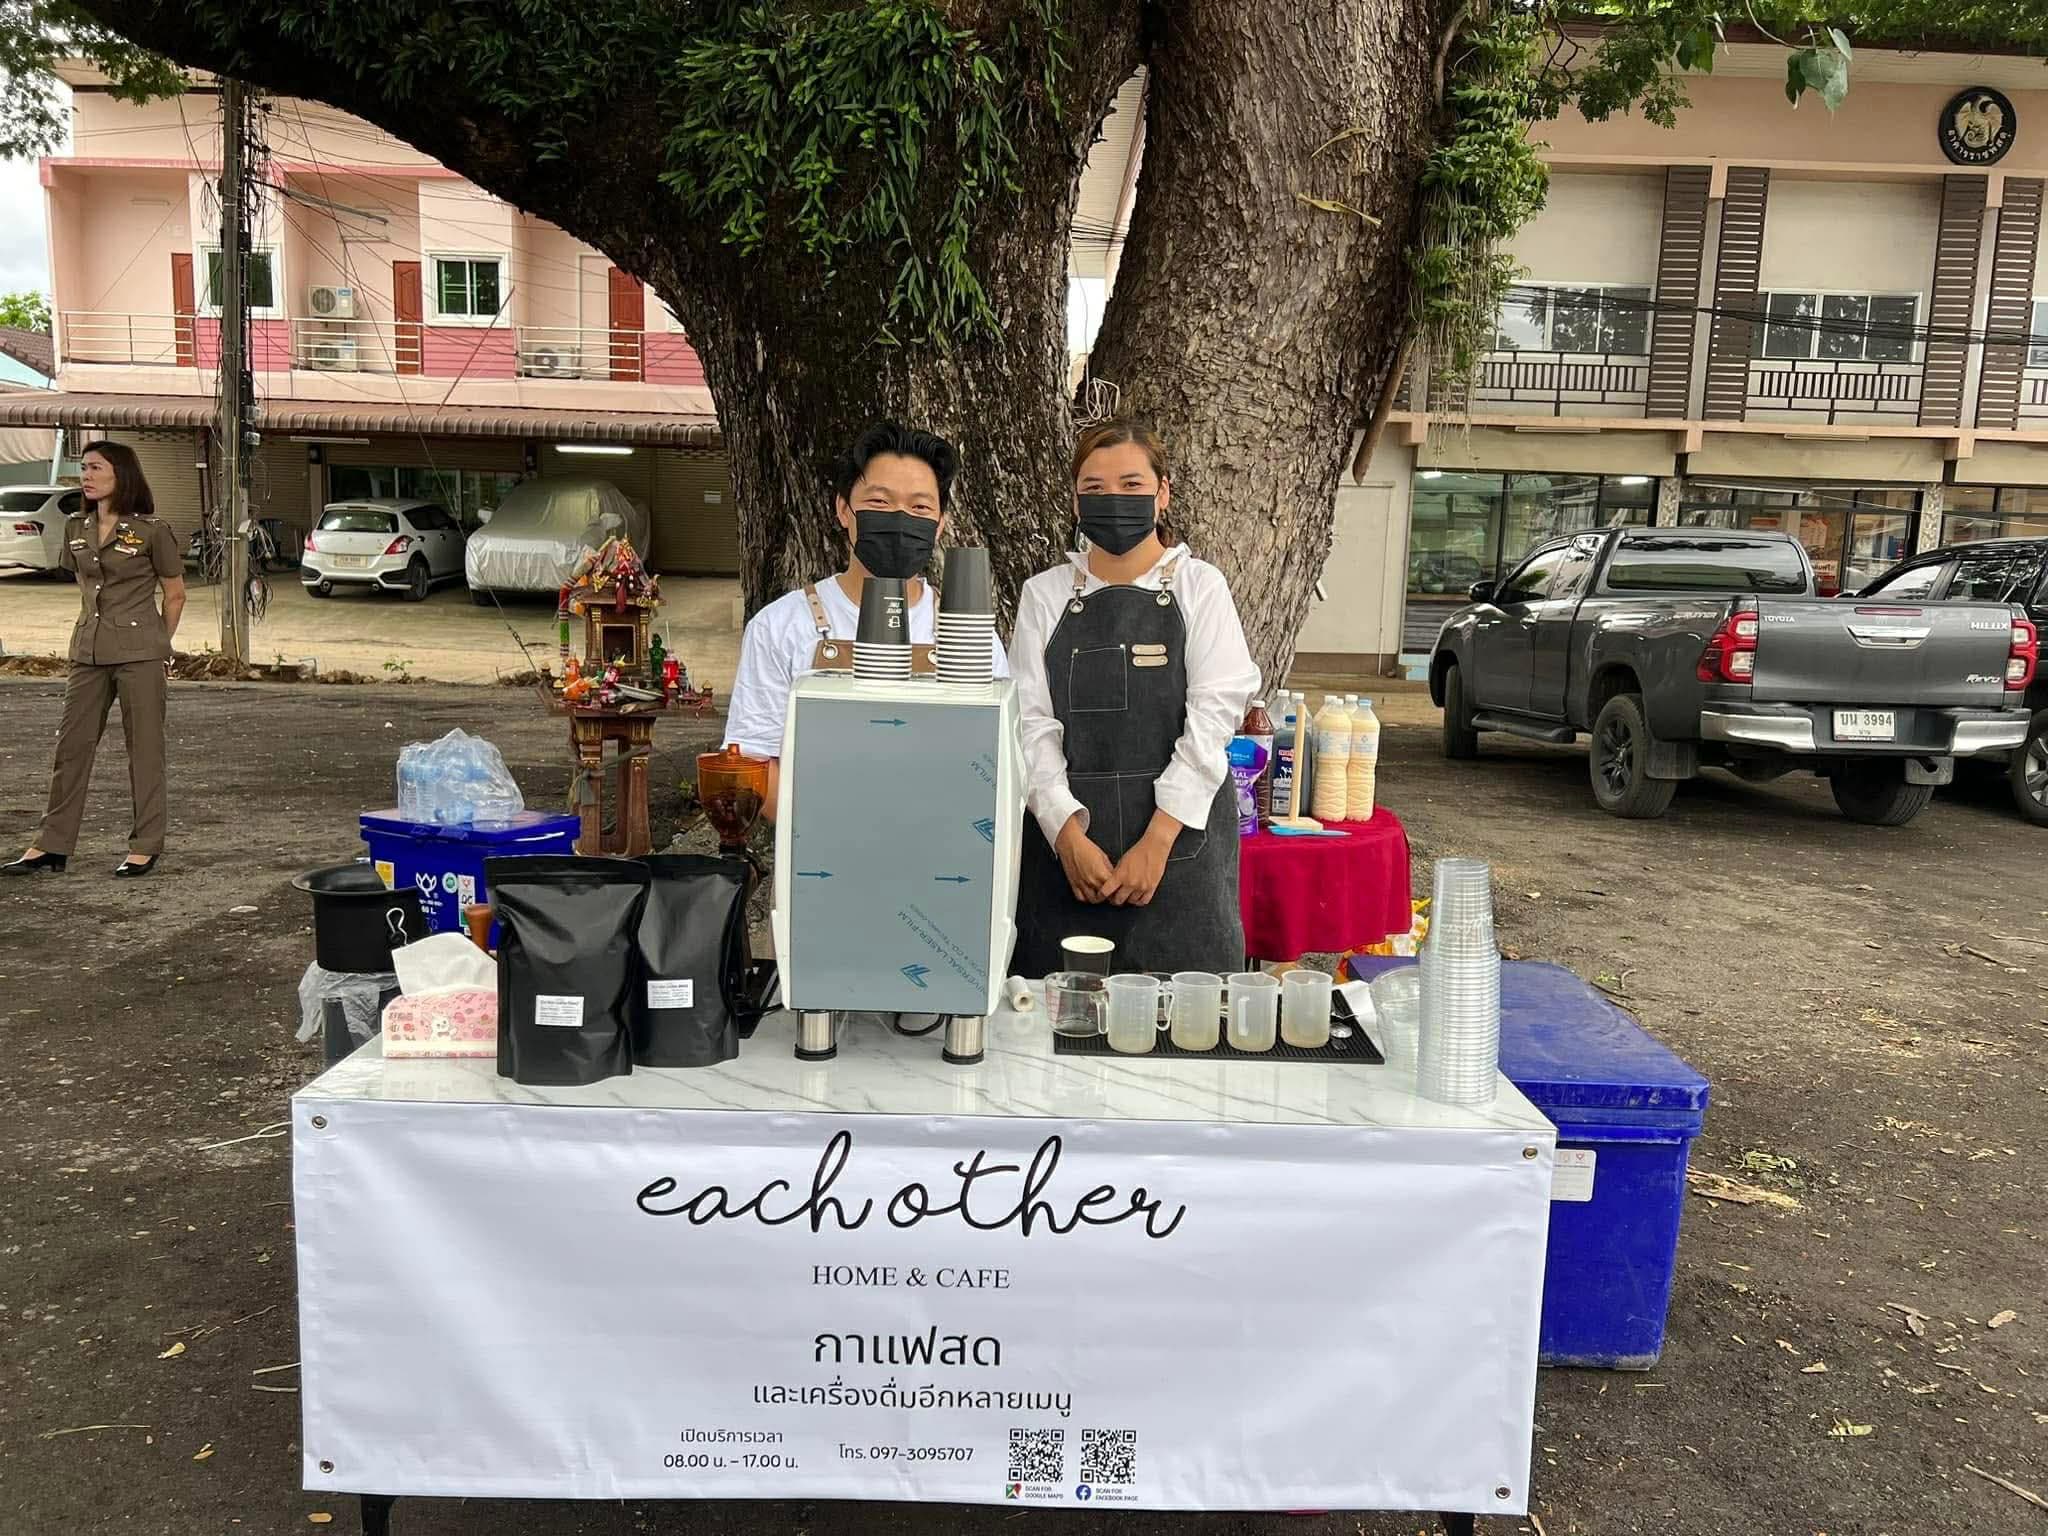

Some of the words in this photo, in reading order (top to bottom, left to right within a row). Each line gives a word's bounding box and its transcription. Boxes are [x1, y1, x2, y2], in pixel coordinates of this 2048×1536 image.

[1970, 621, 2008, 630] HILUX
[1863, 713, 1892, 727] 3994
[636, 1130, 873, 1233] each
[886, 1135, 1187, 1239] other
[811, 1265, 898, 1287] HOME
[906, 1266, 928, 1287] &
[936, 1267, 1011, 1289] CAFE
[814, 1325, 1002, 1366] กาแฟสด
[753, 1375, 1072, 1418] และเครื่องดื่มอีกหลายเมนู
[680, 1427, 783, 1444] เปิดบริการเวลา
[663, 1453, 709, 1468] 08.00
[713, 1455, 727, 1469] น.
[744, 1454, 781, 1469] 17.00
[785, 1456, 799, 1470] น.
[839, 1442, 866, 1460] โทร.
[870, 1446, 975, 1462] 097-3095707
